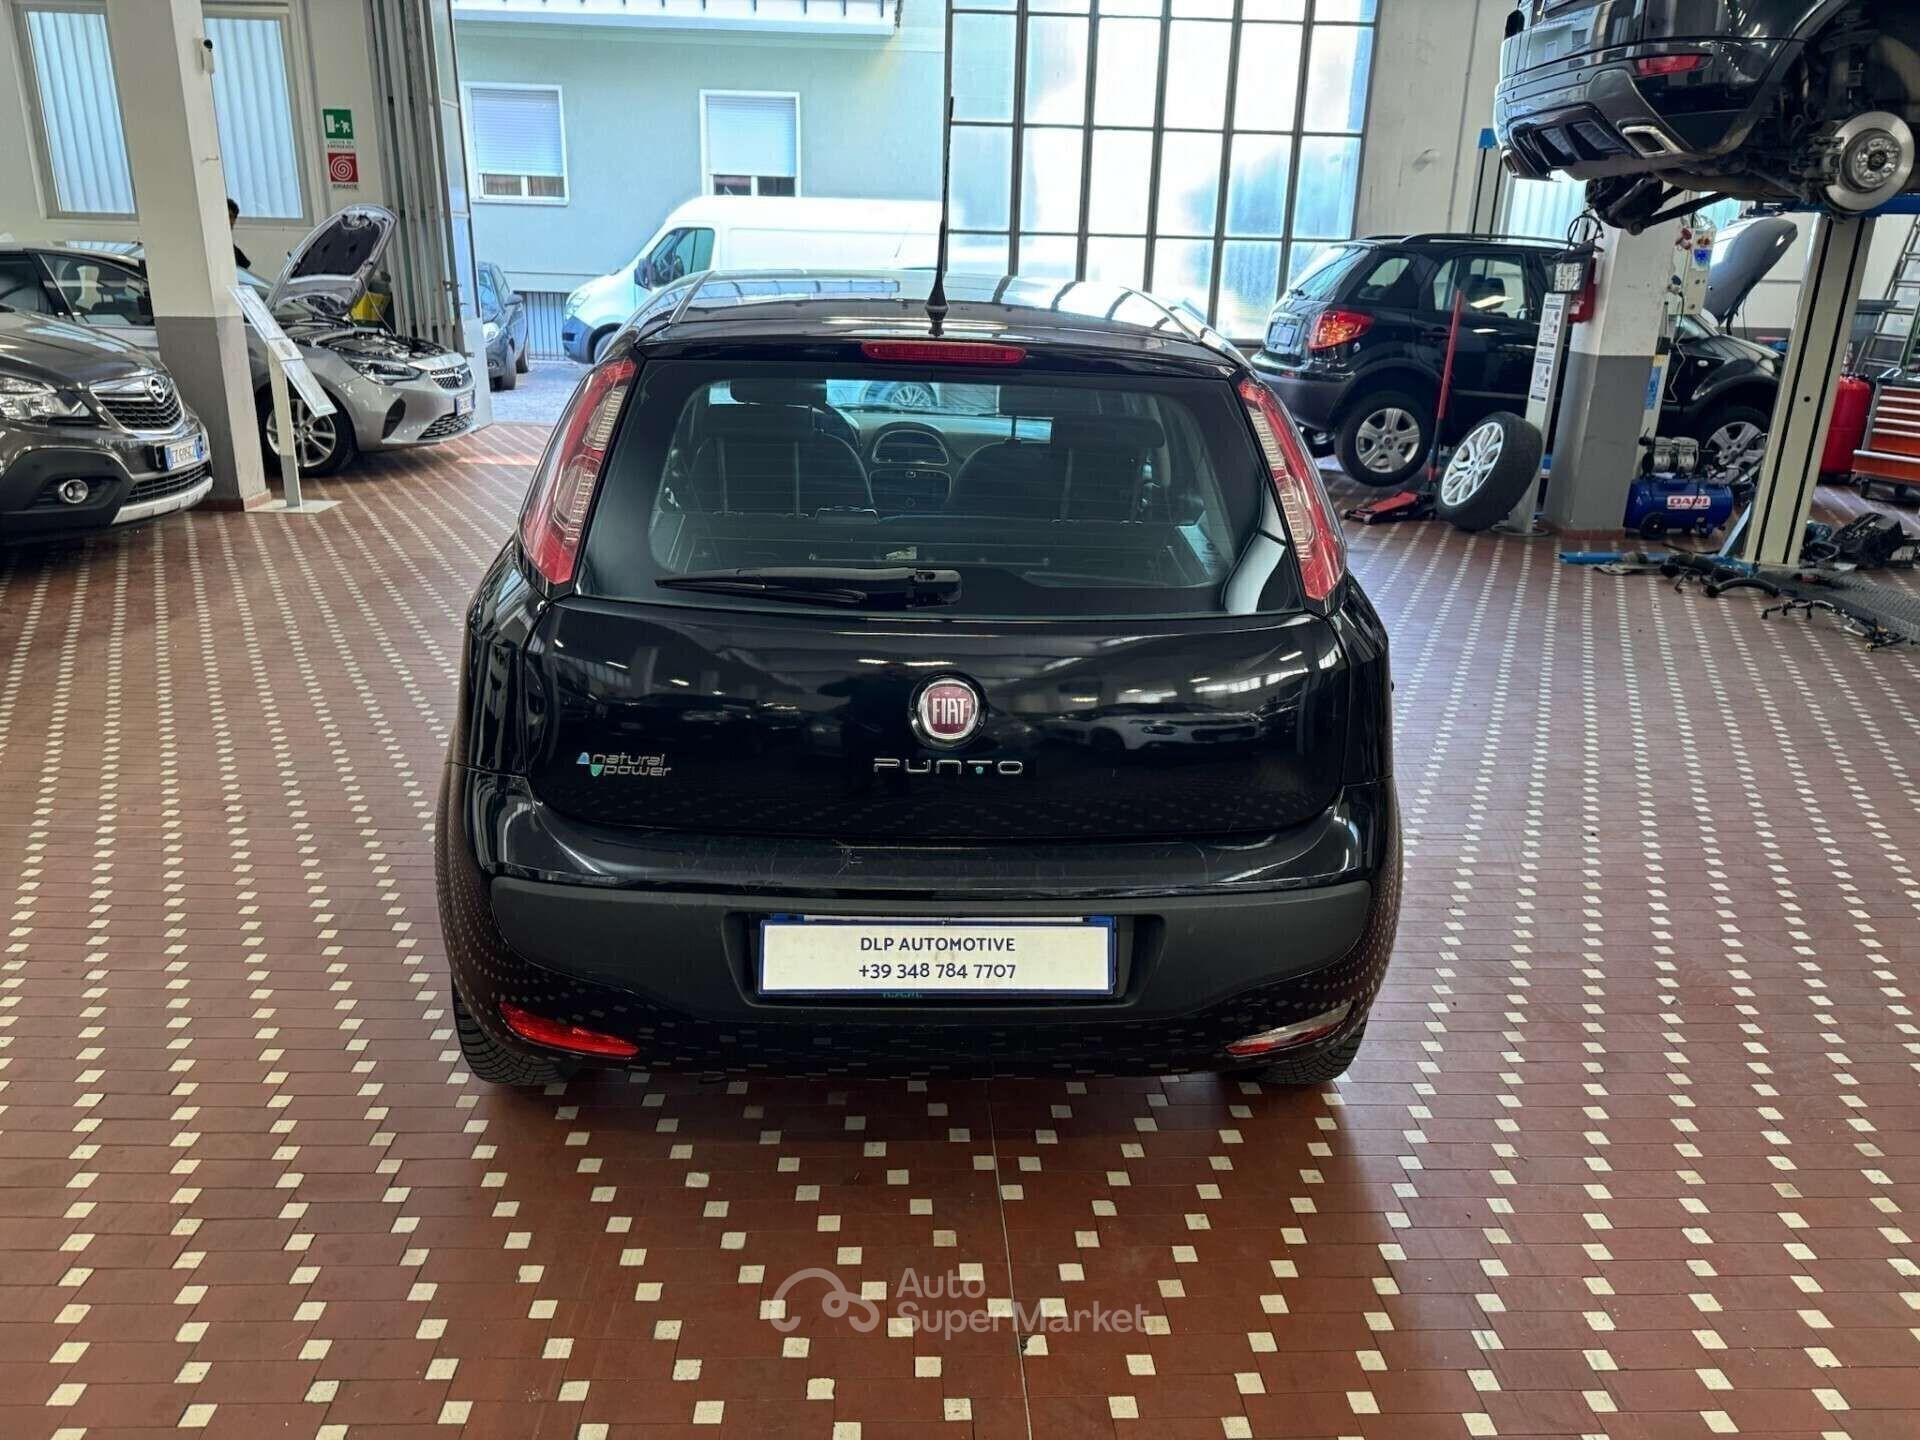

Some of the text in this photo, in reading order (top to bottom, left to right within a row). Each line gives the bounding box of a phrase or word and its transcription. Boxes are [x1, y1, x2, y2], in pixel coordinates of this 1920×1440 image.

[1669, 497, 1708, 506] DARI
[932, 697, 968, 725] FIAT
[592, 752, 666, 767] natural
[872, 757, 1025, 776] PUNTO
[602, 764, 673, 777] power
[860, 937, 1016, 952] DLP AUTOMOTIVE
[858, 962, 1017, 979] +39 348 784 7707
